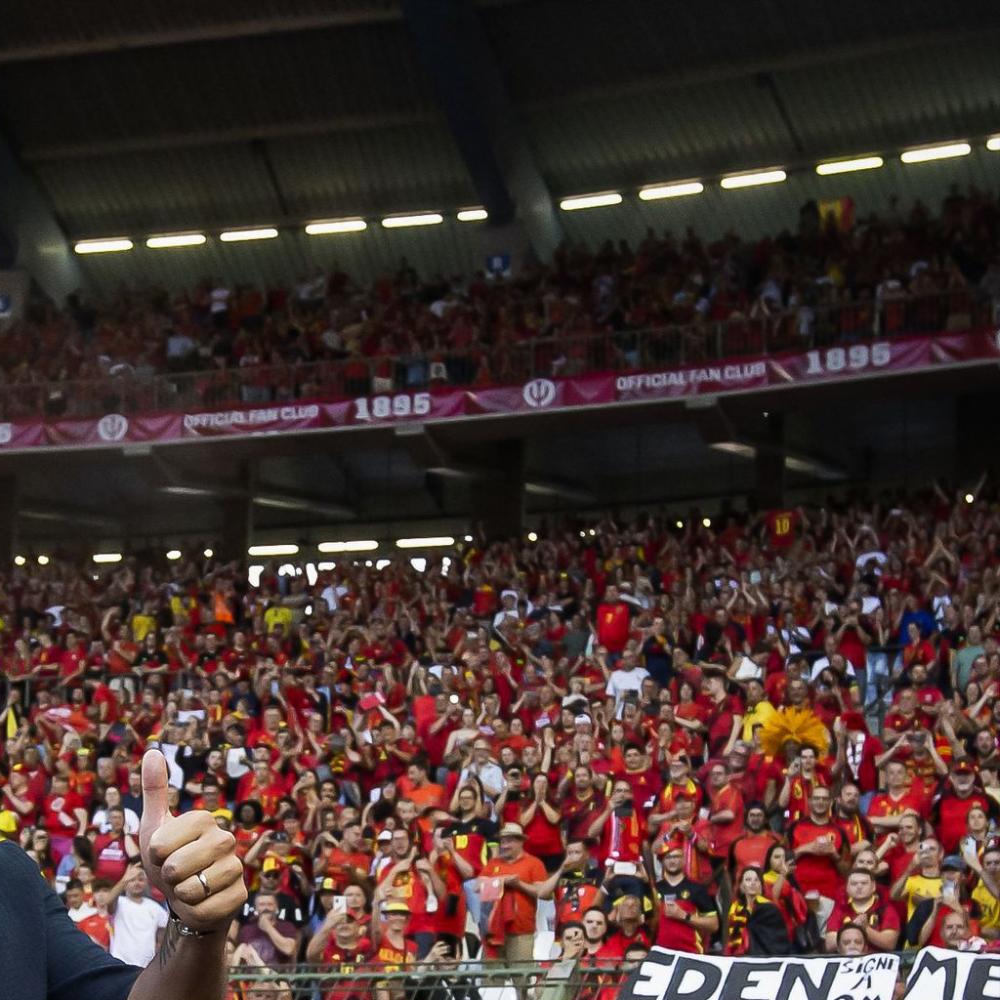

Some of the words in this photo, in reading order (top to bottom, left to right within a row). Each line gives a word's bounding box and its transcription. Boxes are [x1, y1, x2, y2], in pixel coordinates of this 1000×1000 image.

[807, 343, 891, 374] 1895
[616, 370, 686, 391] OFFICIAL
[689, 367, 721, 383] FAN
[723, 361, 767, 380] CLUB
[354, 393, 430, 419] 1895
